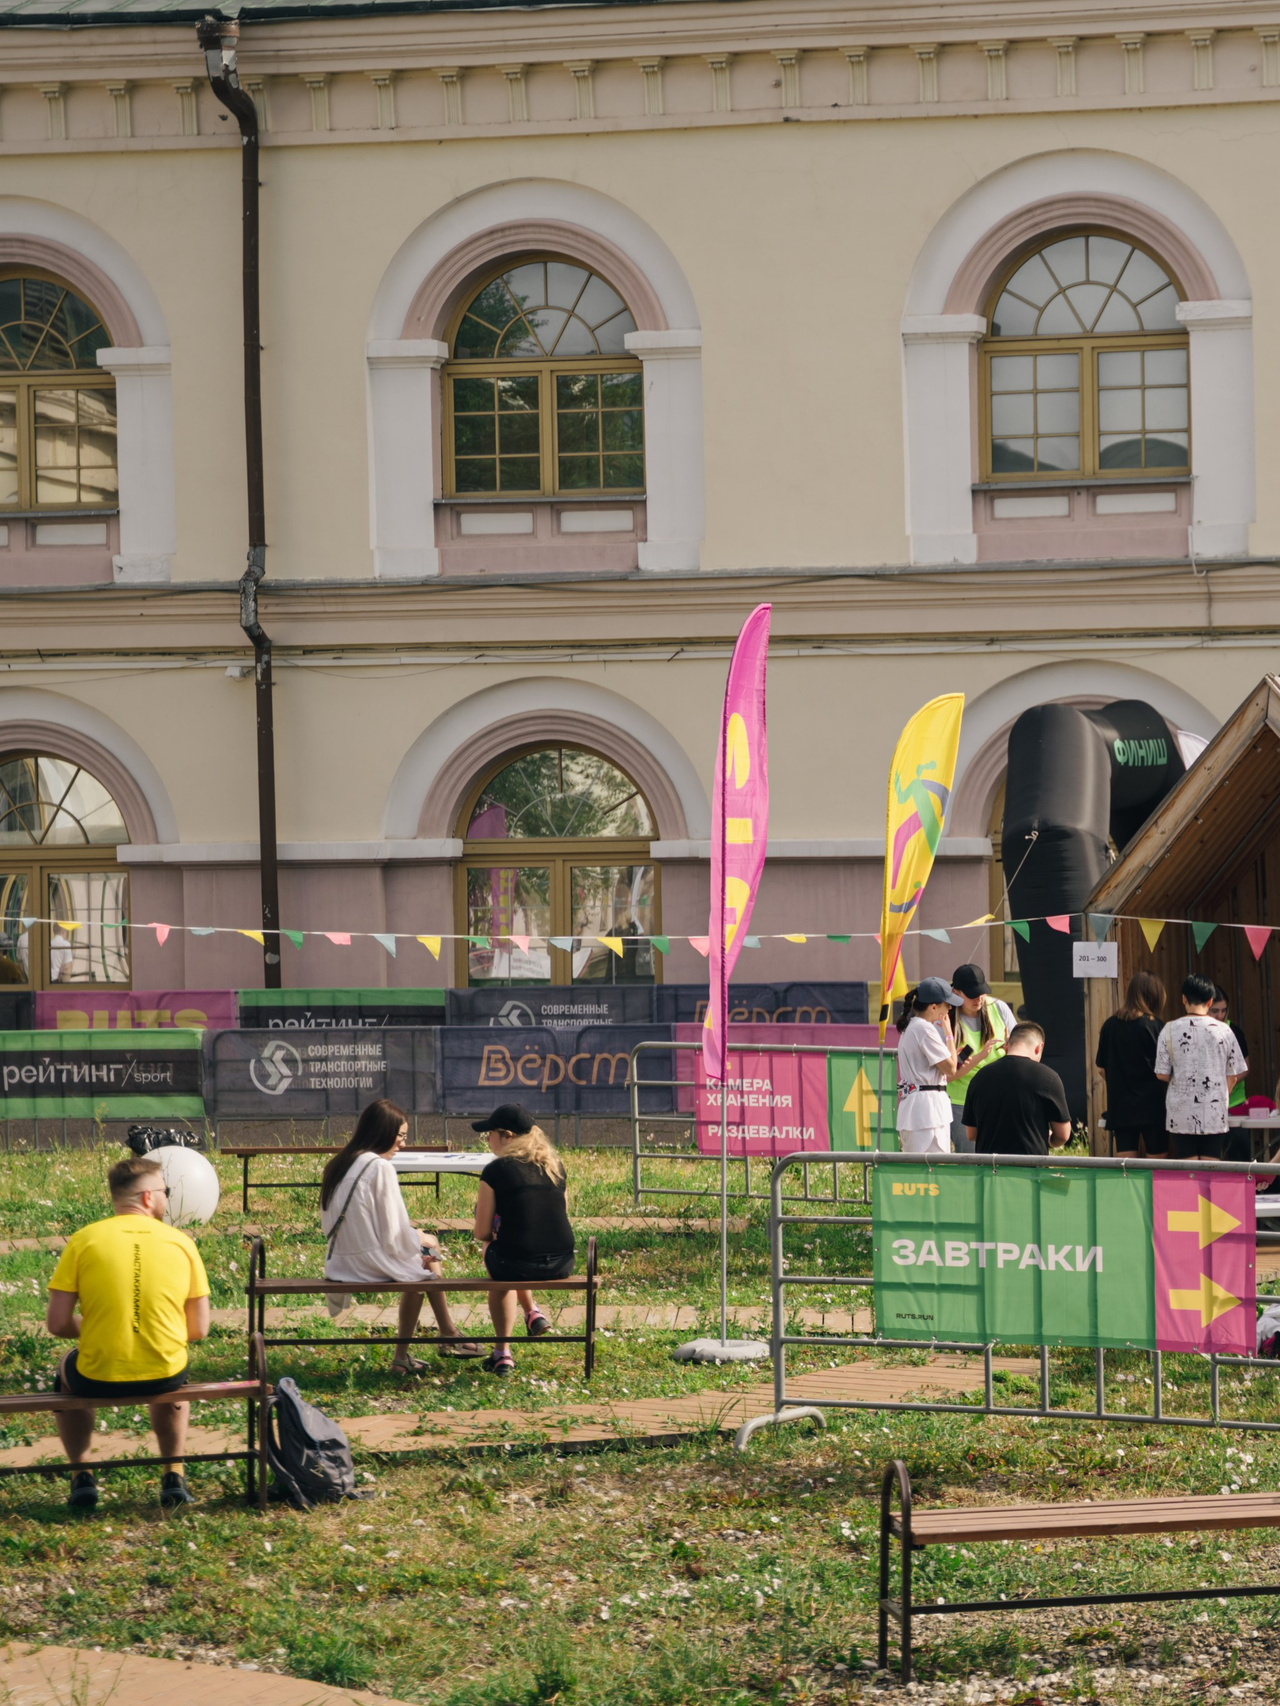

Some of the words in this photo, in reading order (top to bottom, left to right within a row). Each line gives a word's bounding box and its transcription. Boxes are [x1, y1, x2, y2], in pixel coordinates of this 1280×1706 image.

[1113, 738, 1168, 766] ФИНИШ
[1096, 955, 1107, 963] 300
[541, 1003, 609, 1015] СОВРЕМЕННЫЕ
[307, 1044, 382, 1056] СОВРЕМЕННЫЕ
[309, 1060, 387, 1073] ТРАНСПОРТНЫЕ
[310, 1077, 373, 1089] ТЕХНОЛОГИИ
[891, 1182, 940, 1197] RUTS
[891, 1238, 1104, 1273] ЗАВТРАКИ
[896, 1312, 934, 1321] RUTS.RUN
